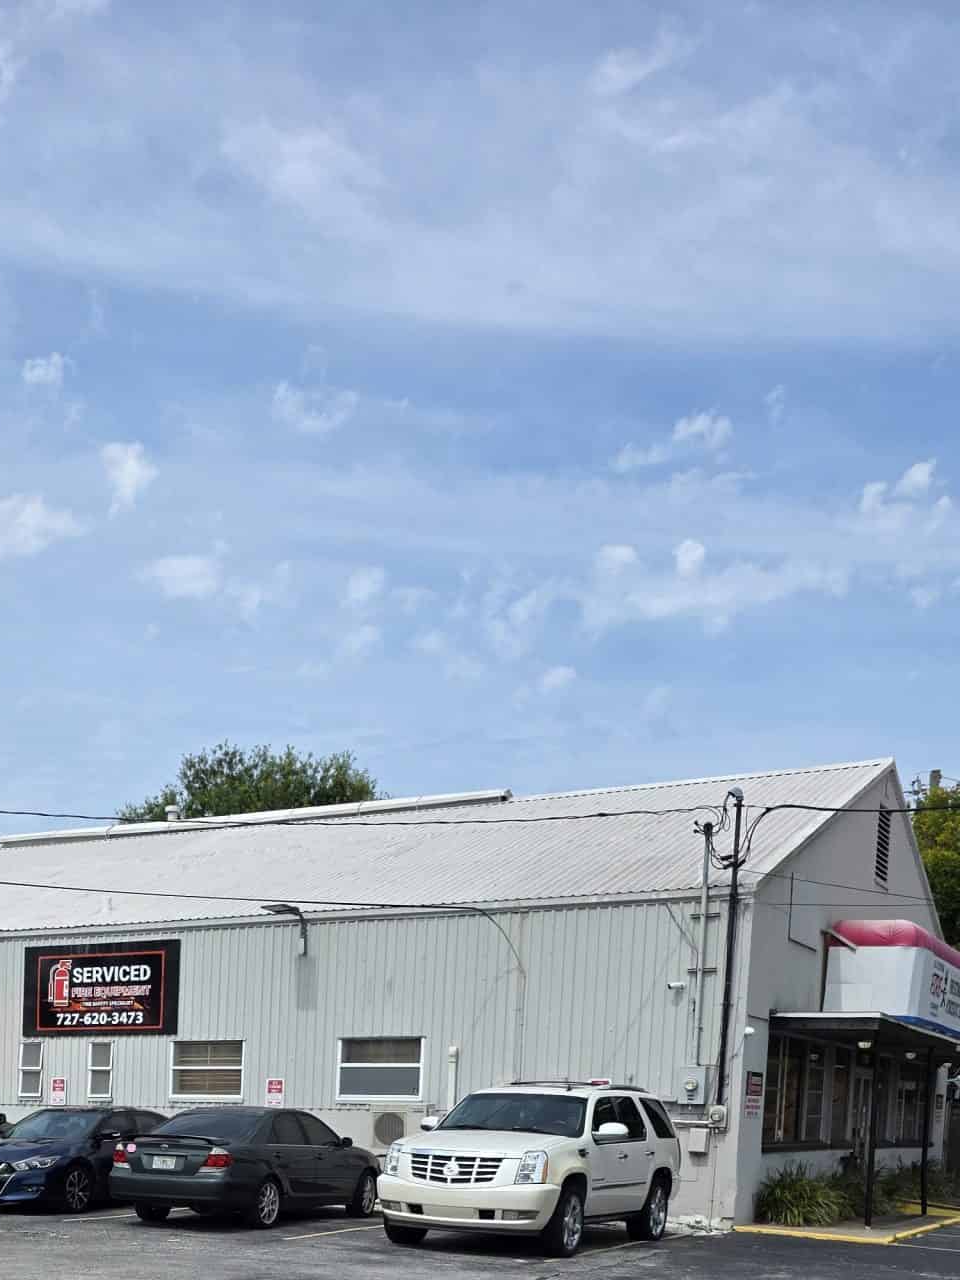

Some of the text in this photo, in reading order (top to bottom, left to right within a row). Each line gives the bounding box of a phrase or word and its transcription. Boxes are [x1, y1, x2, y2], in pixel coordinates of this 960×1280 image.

[72, 964, 152, 983] SERVICED
[71, 984, 152, 999] FIRE EQUIPMENT
[56, 1012, 144, 1026] 727-620-3473
